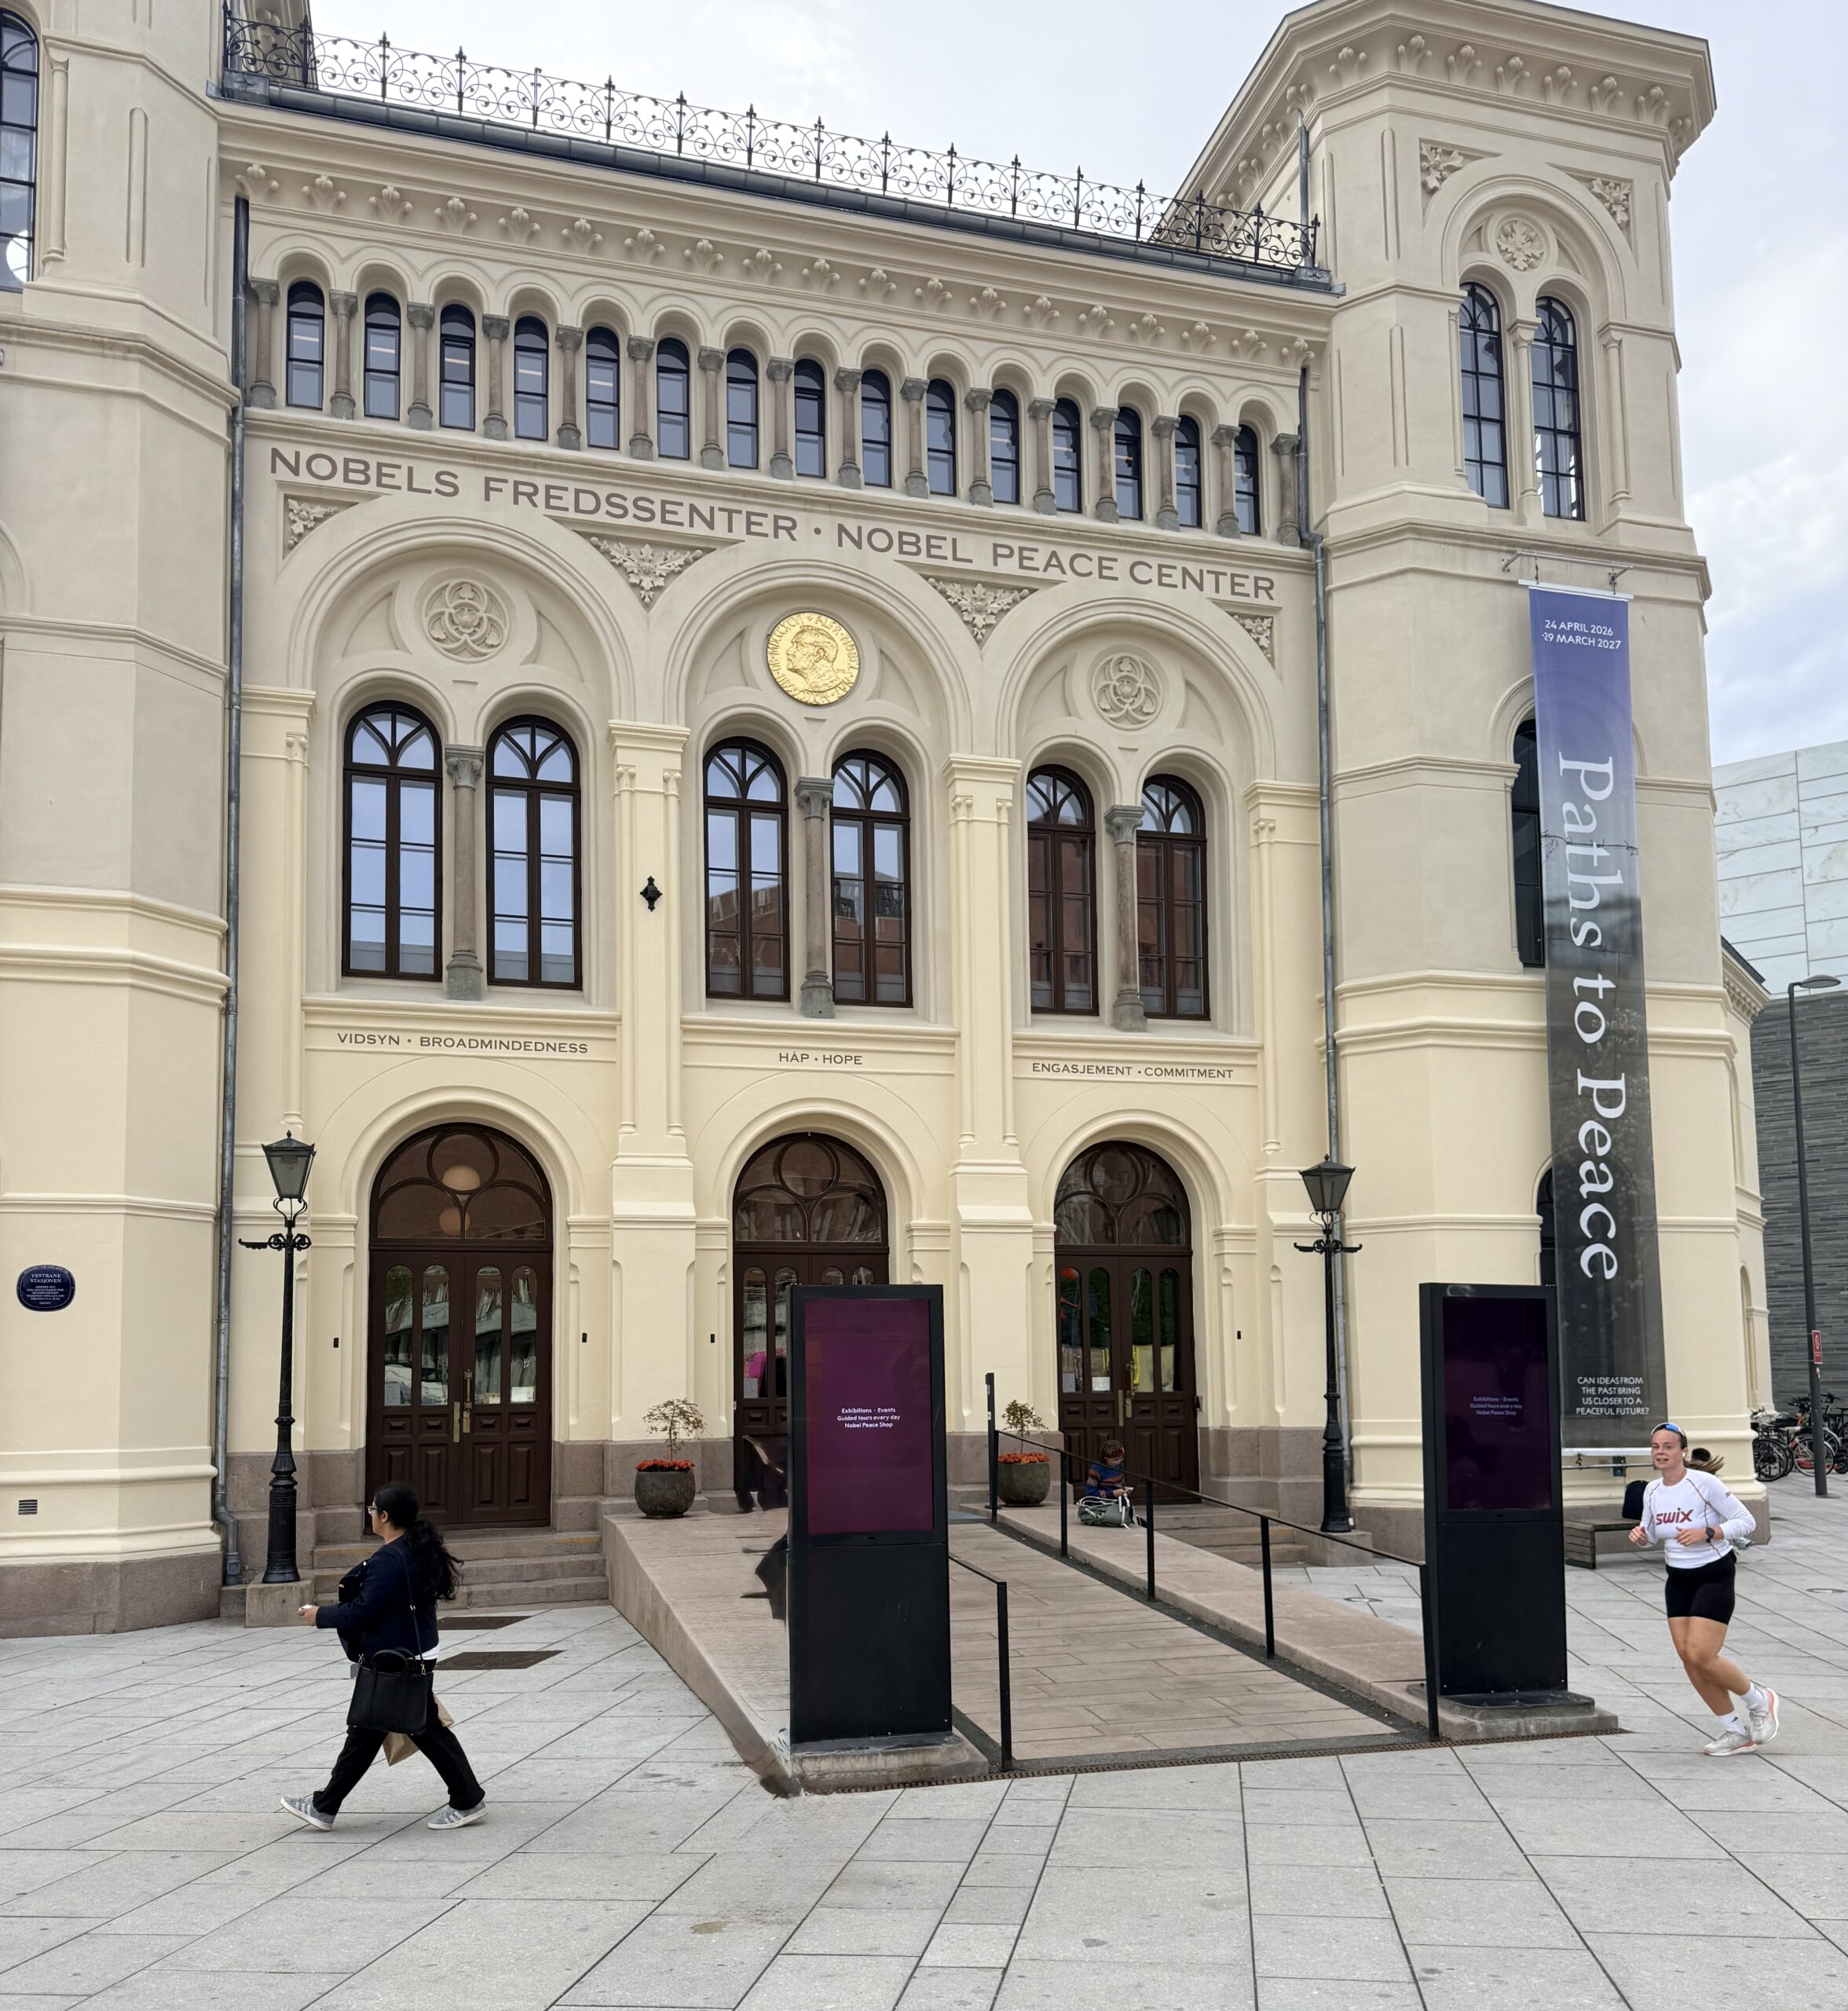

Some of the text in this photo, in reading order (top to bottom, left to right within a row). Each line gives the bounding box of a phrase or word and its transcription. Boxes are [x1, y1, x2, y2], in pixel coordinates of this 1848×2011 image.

[271, 448, 1274, 600] NOBELS FREDSSENTER NOBEL PEACE CENTER
[1546, 619, 1613, 636] 24 APRIL 2026
[1557, 634, 1595, 646] MARCH
[1597, 639, 1621, 649] 2027
[840, 635, 858, 670] NOBEL
[1559, 751, 1627, 1280] Paths to Peace
[338, 1033, 587, 1053] VIDSYN BROADMINDEDNESS
[779, 1051, 862, 1064] HÅP HOPE
[1032, 1063, 1233, 1078] ENGASJEMENT COMMITMENT
